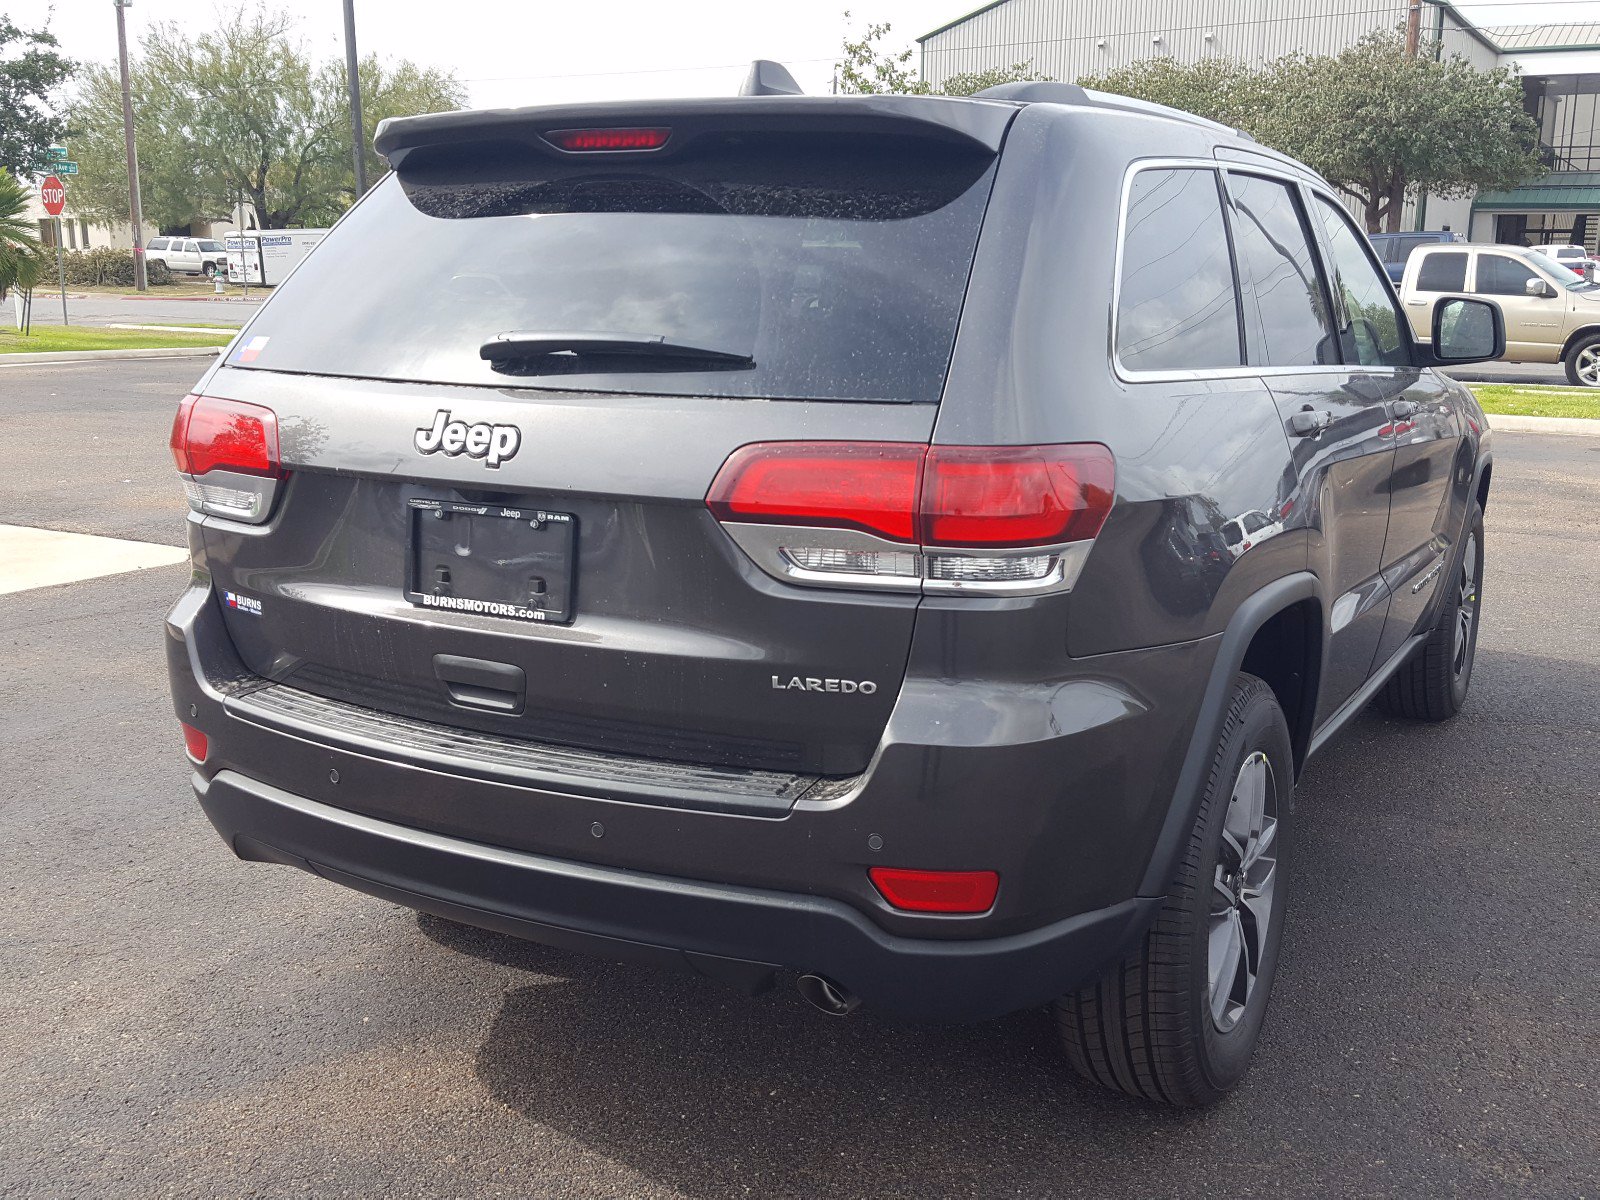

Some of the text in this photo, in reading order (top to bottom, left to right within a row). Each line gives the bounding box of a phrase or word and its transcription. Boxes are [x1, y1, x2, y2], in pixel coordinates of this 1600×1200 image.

[42, 189, 63, 204] STOP
[414, 409, 521, 468] Jeep
[500, 508, 521, 519] Jeep
[237, 595, 262, 610] BURNS
[423, 596, 545, 620] BURNSMOTORS.com
[771, 675, 877, 694] LAREDO
